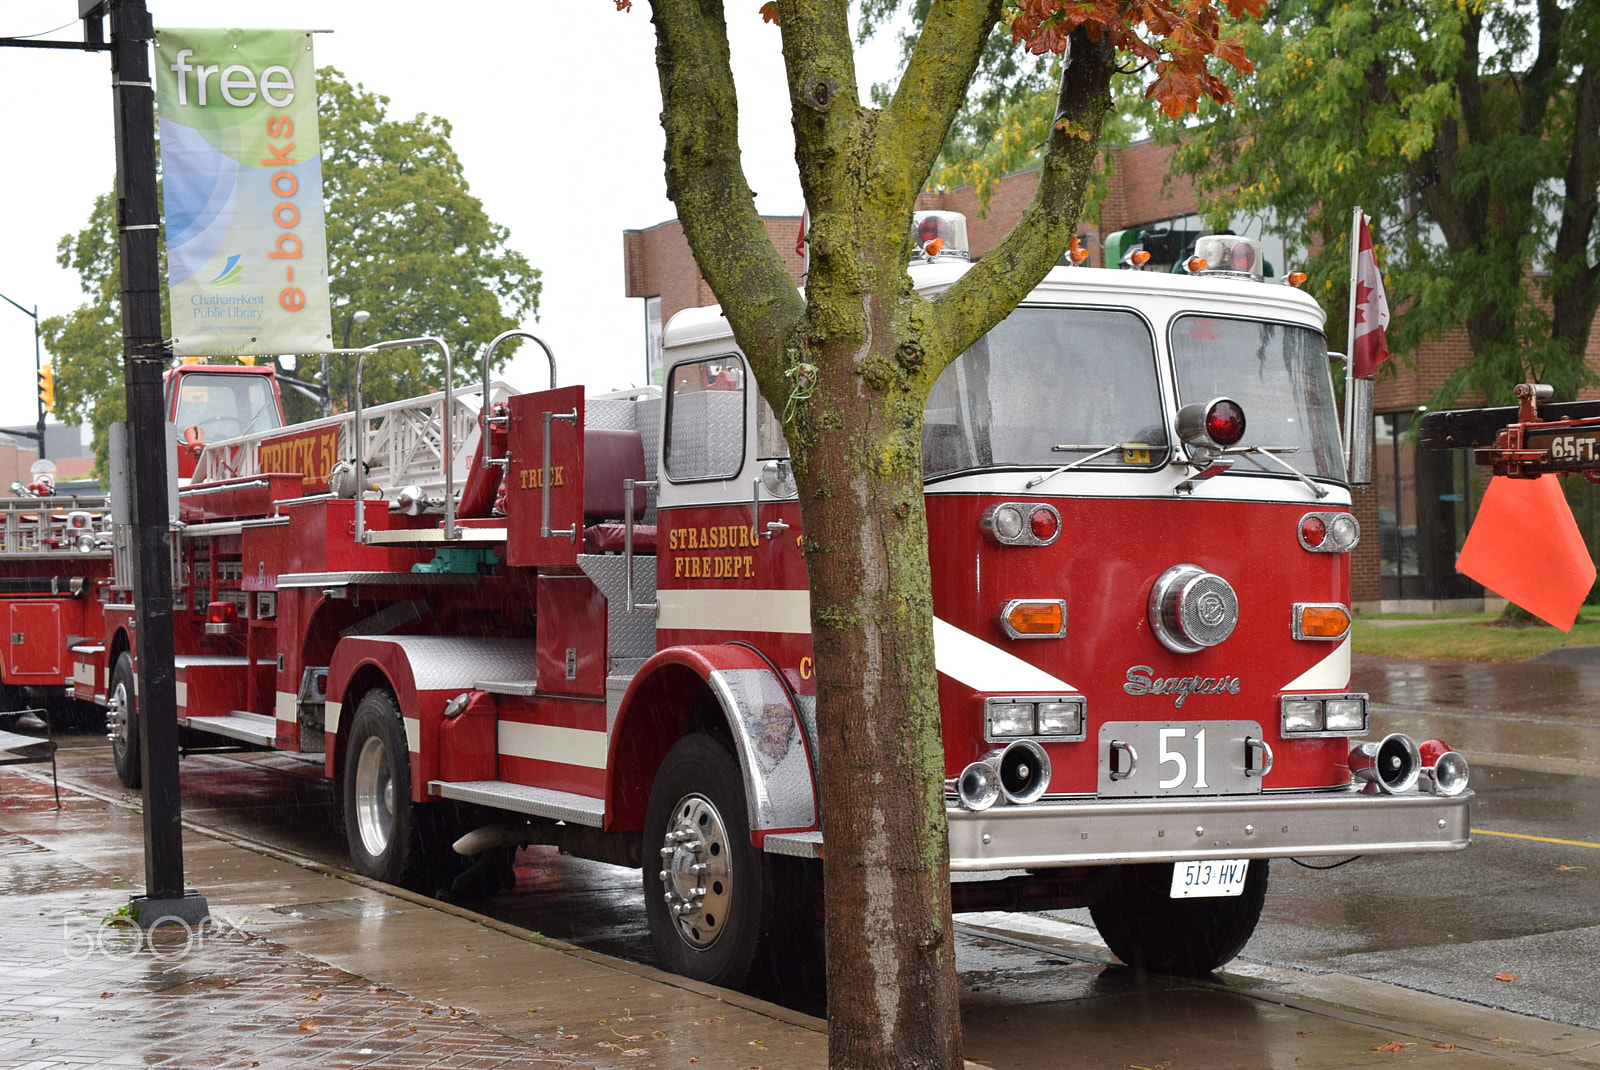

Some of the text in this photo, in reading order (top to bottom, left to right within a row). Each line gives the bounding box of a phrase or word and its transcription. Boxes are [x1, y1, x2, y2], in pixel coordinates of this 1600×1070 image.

[170, 49, 295, 107] free
[260, 116, 305, 312] e-books
[191, 293, 264, 305] Chatham-Kent
[193, 306, 264, 320] Public Library
[261, 432, 337, 486] TRUCK 51
[669, 525, 760, 550] STRASBURG
[674, 556, 755, 579] FIRE DEPT.
[1123, 665, 1240, 708] Seagrave
[1159, 727, 1209, 789] 51
[1185, 865, 1212, 886] 513
